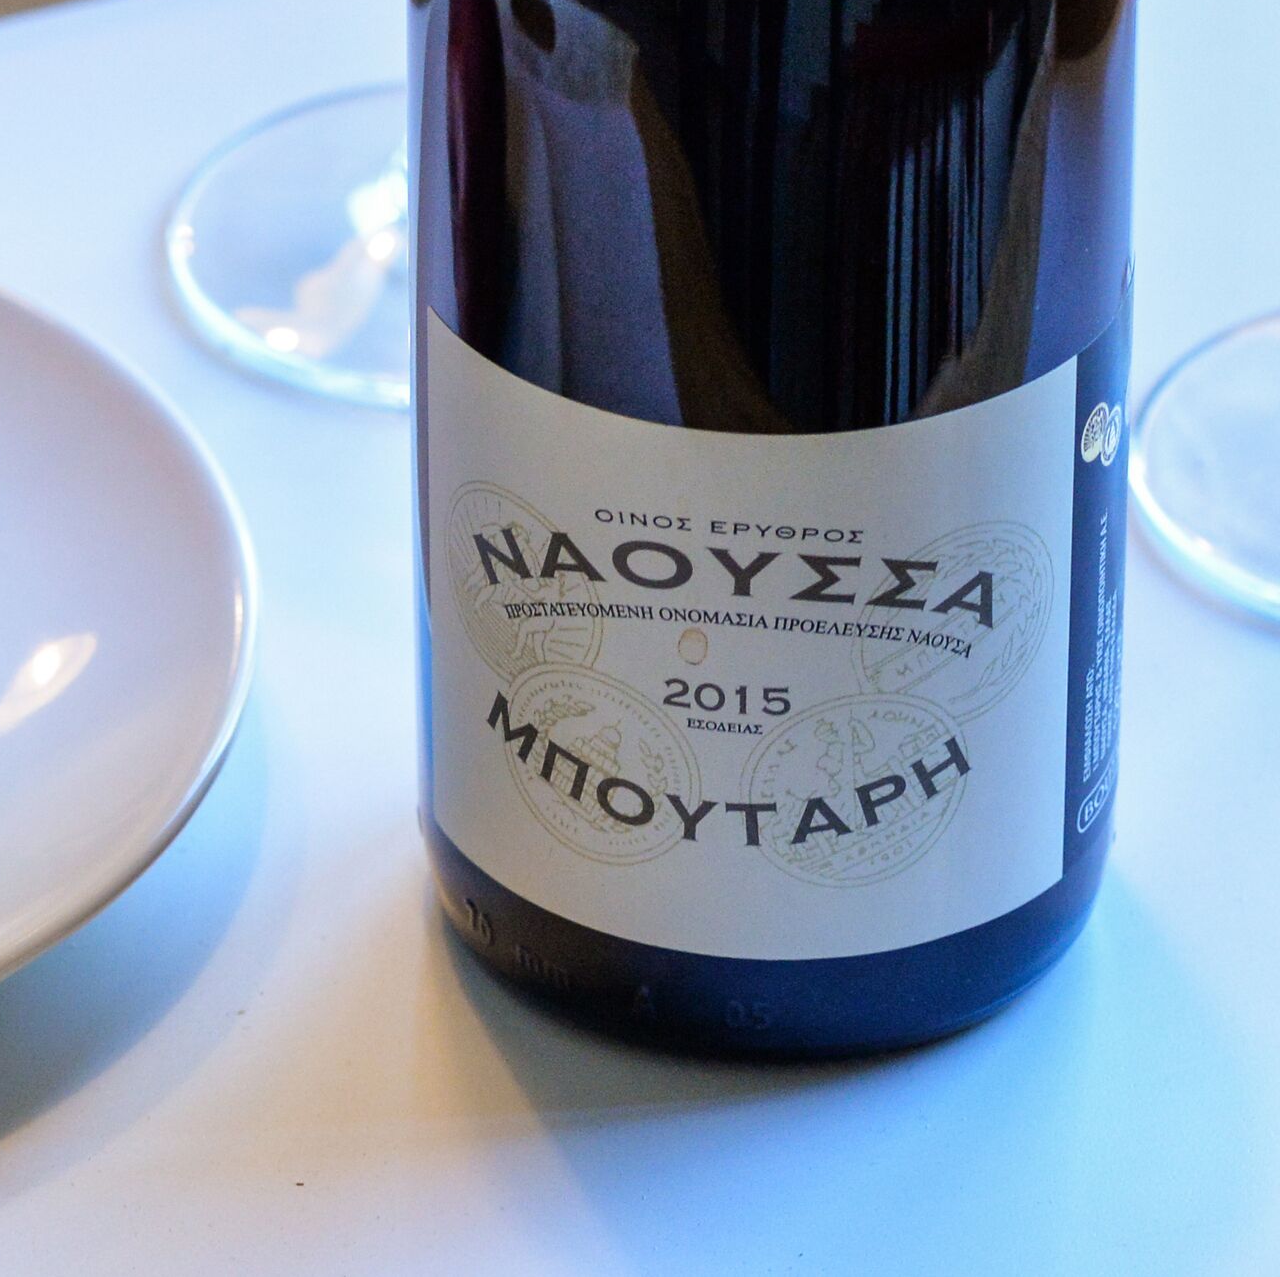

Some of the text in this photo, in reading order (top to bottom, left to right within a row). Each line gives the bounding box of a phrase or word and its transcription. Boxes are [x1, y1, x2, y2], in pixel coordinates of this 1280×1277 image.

[594, 508, 864, 544] ΟΙΝΟΣ ΕΡΥΘΡΟΣ
[472, 527, 994, 630] ΝΑΟΥΣΣΑ
[503, 601, 973, 659] ΠΡΟΣΤΑΤΕΥΟΜΕΝΗ ΟΝΟΜΑΣΙΑ ΠΡΟΕΛΕΥΣΗΣ ΝΑΟΥΣΑ
[662, 678, 791, 716] 2015
[686, 716, 764, 736] ΕΣΟΔΕΙΑΣ
[485, 689, 972, 847] ΜΠΟΥΤΑΡΗ
